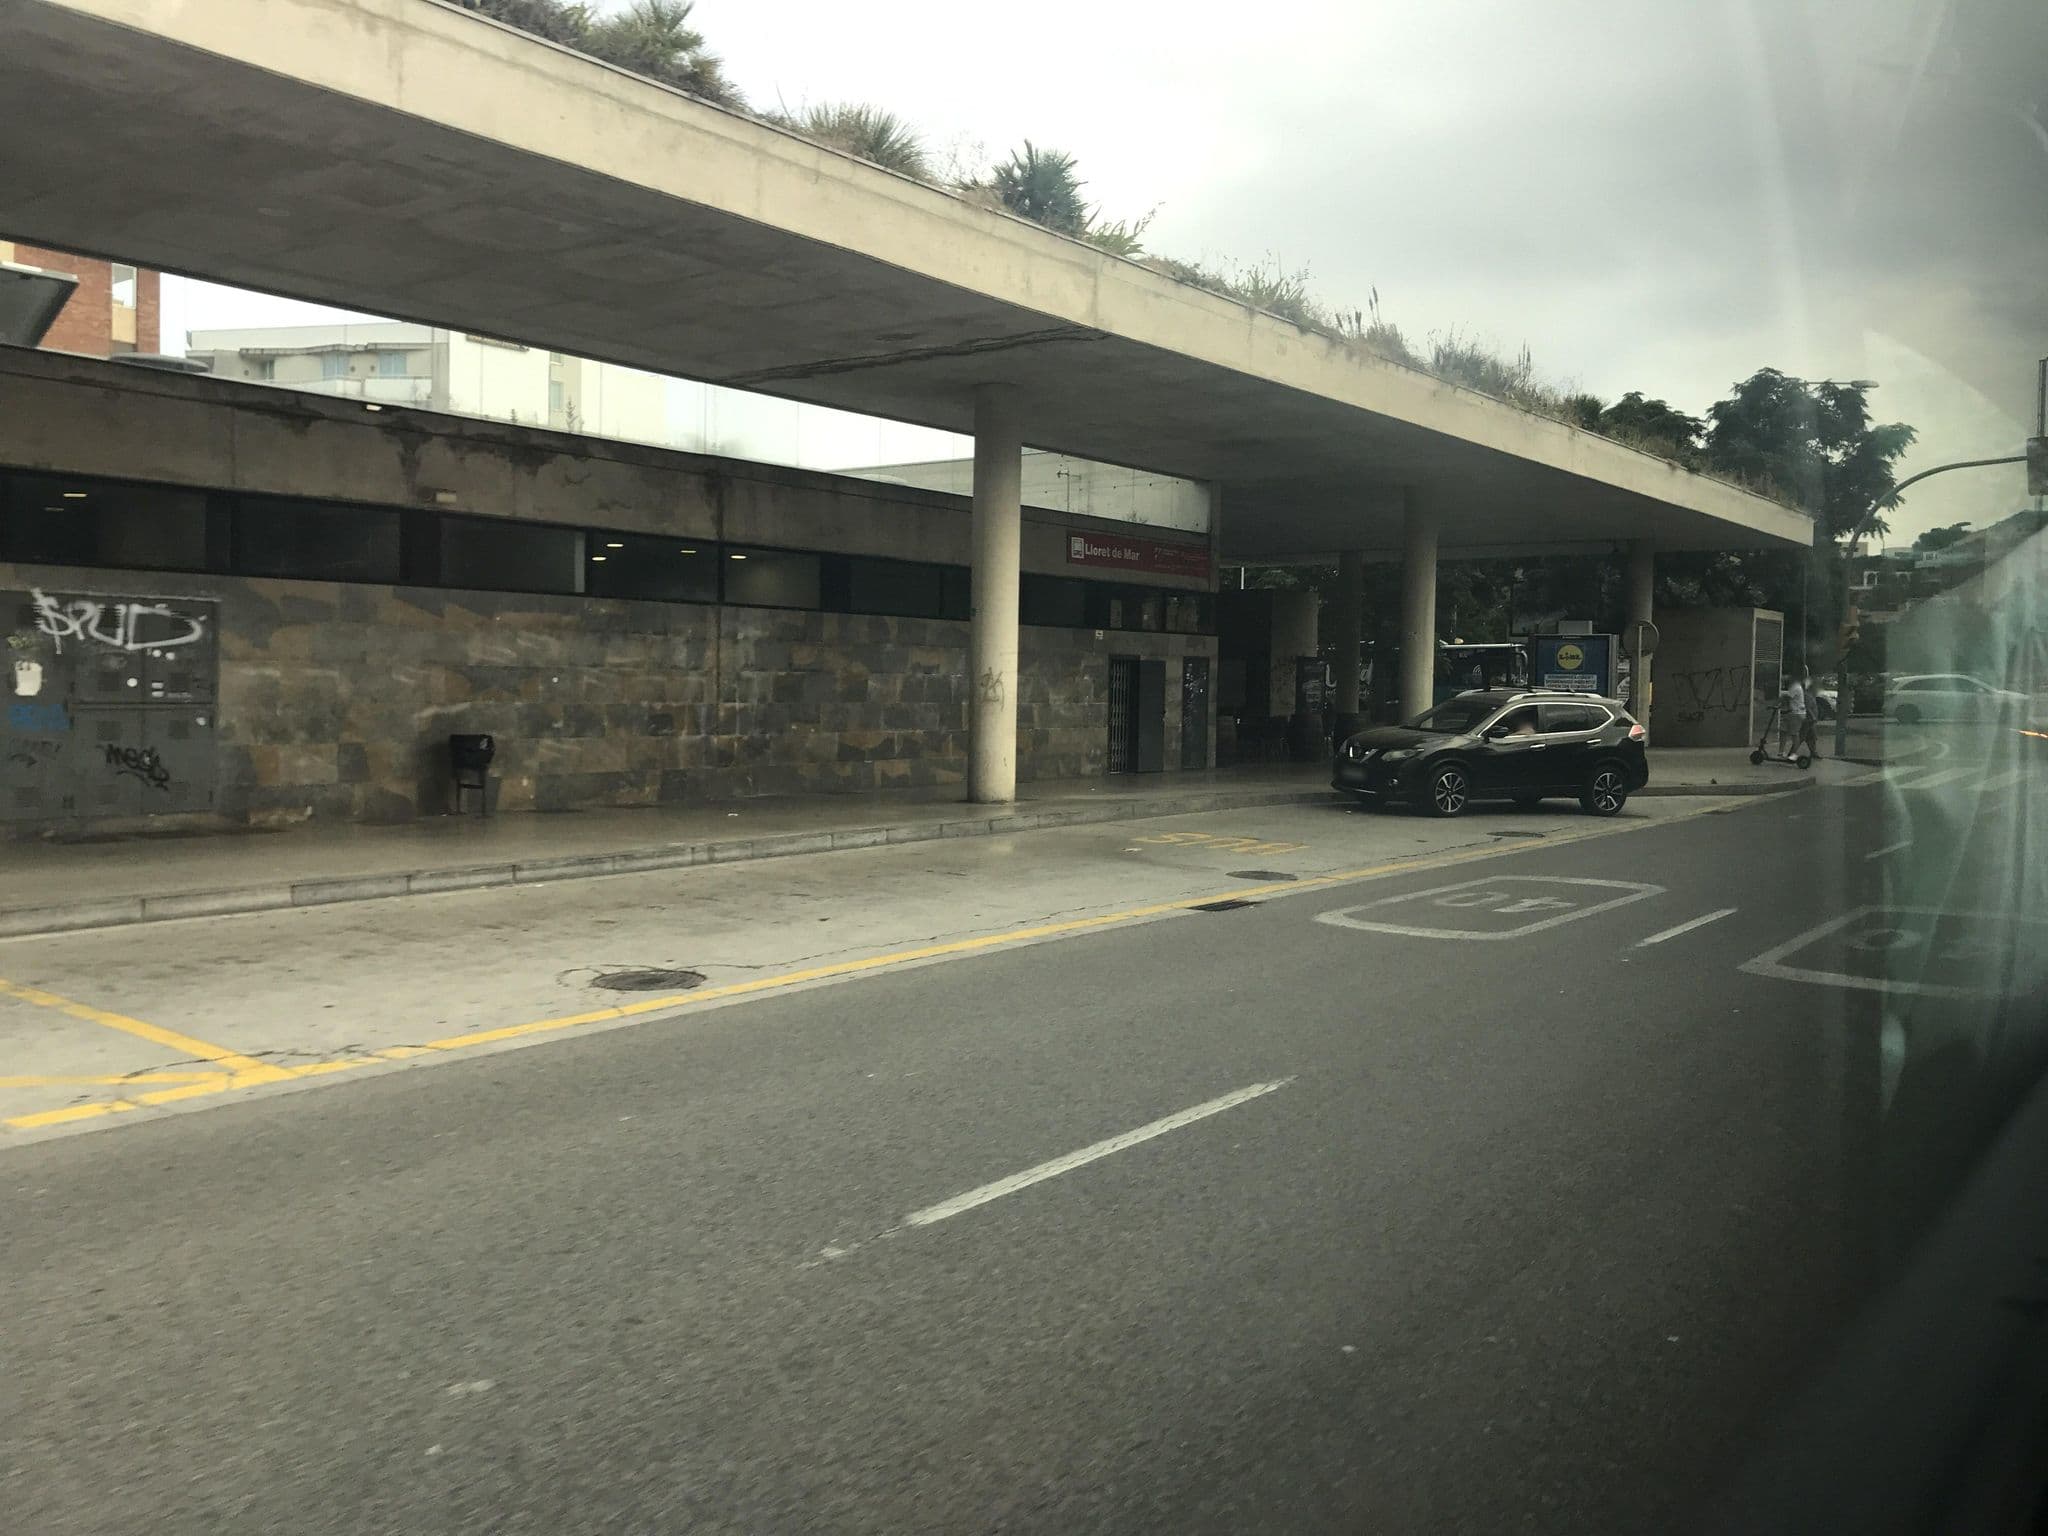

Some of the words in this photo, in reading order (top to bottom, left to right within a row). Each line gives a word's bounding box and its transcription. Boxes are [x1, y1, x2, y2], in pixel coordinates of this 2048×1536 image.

[1085, 543, 1110, 558] Lloret
[1111, 547, 1122, 559] de
[1123, 548, 1141, 561] Mar
